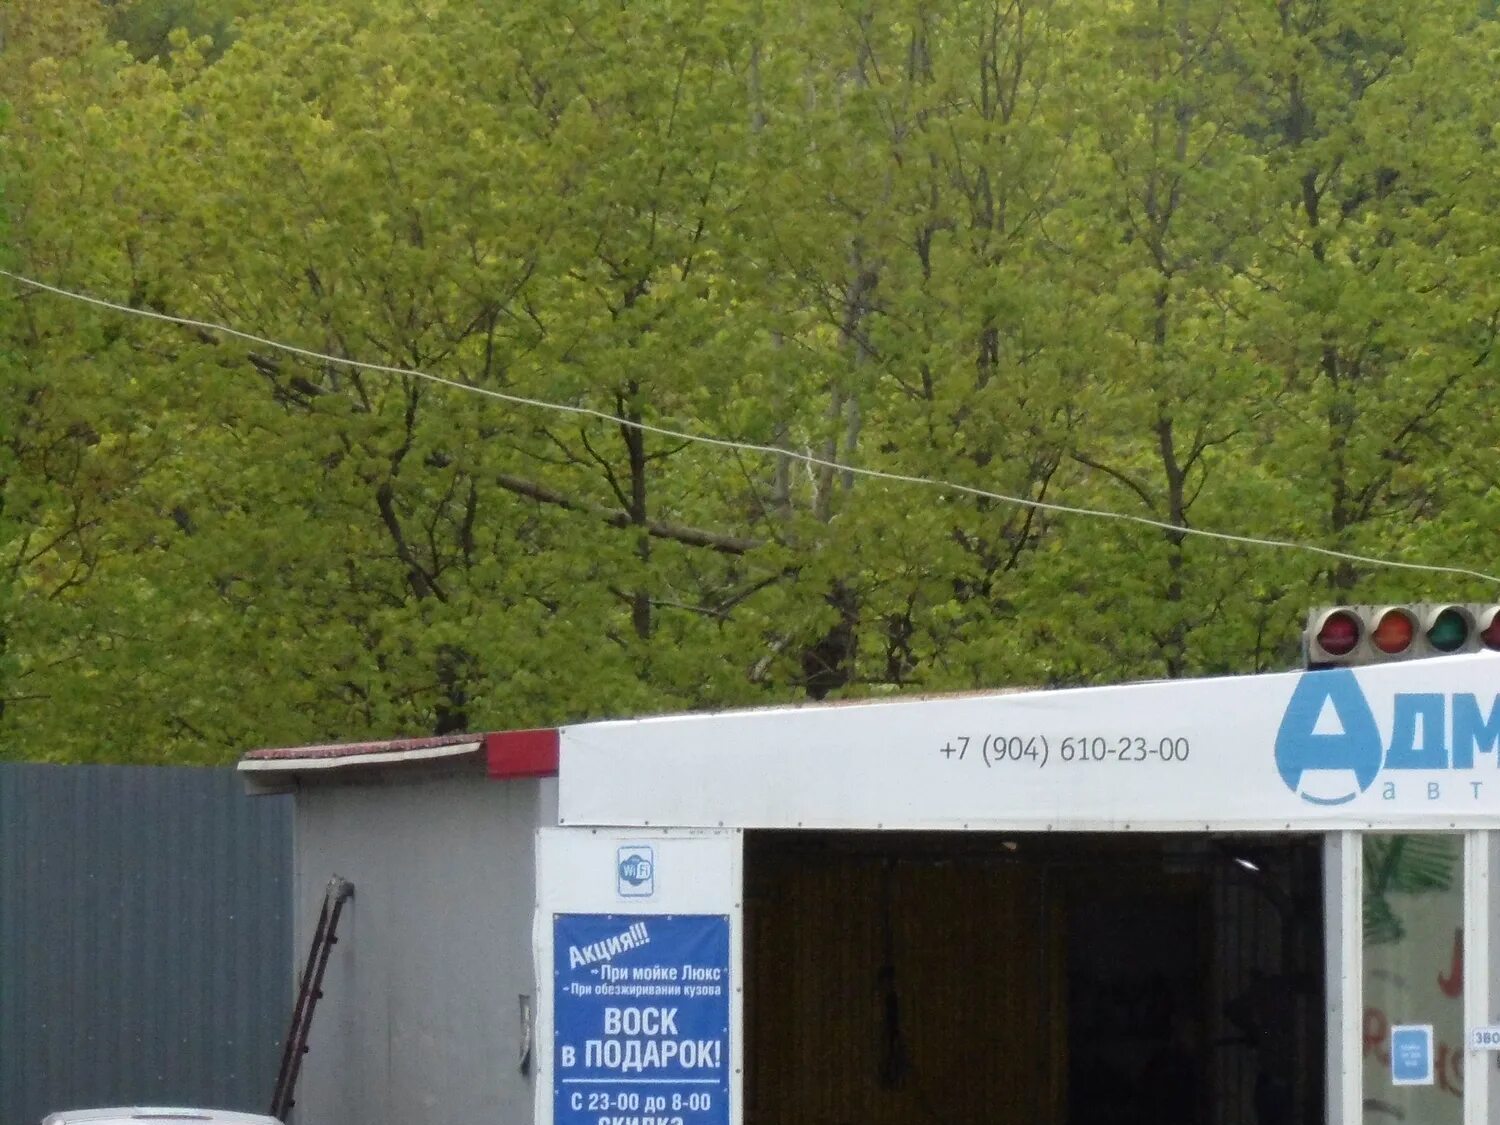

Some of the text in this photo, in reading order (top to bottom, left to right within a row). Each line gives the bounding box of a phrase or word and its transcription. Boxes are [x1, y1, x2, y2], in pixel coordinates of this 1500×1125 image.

[939, 736, 1190, 768] +7 (904) 610-23-00
[568, 922, 650, 969] Акция!!!
[601, 965, 721, 981] При мойке Люкс
[571, 983, 721, 997] При обезжиривании кузова
[604, 1008, 678, 1035] ВОСК
[585, 1040, 721, 1072] ПОДАРОК!
[571, 1093, 710, 1114] С 23-00 до 8-00
